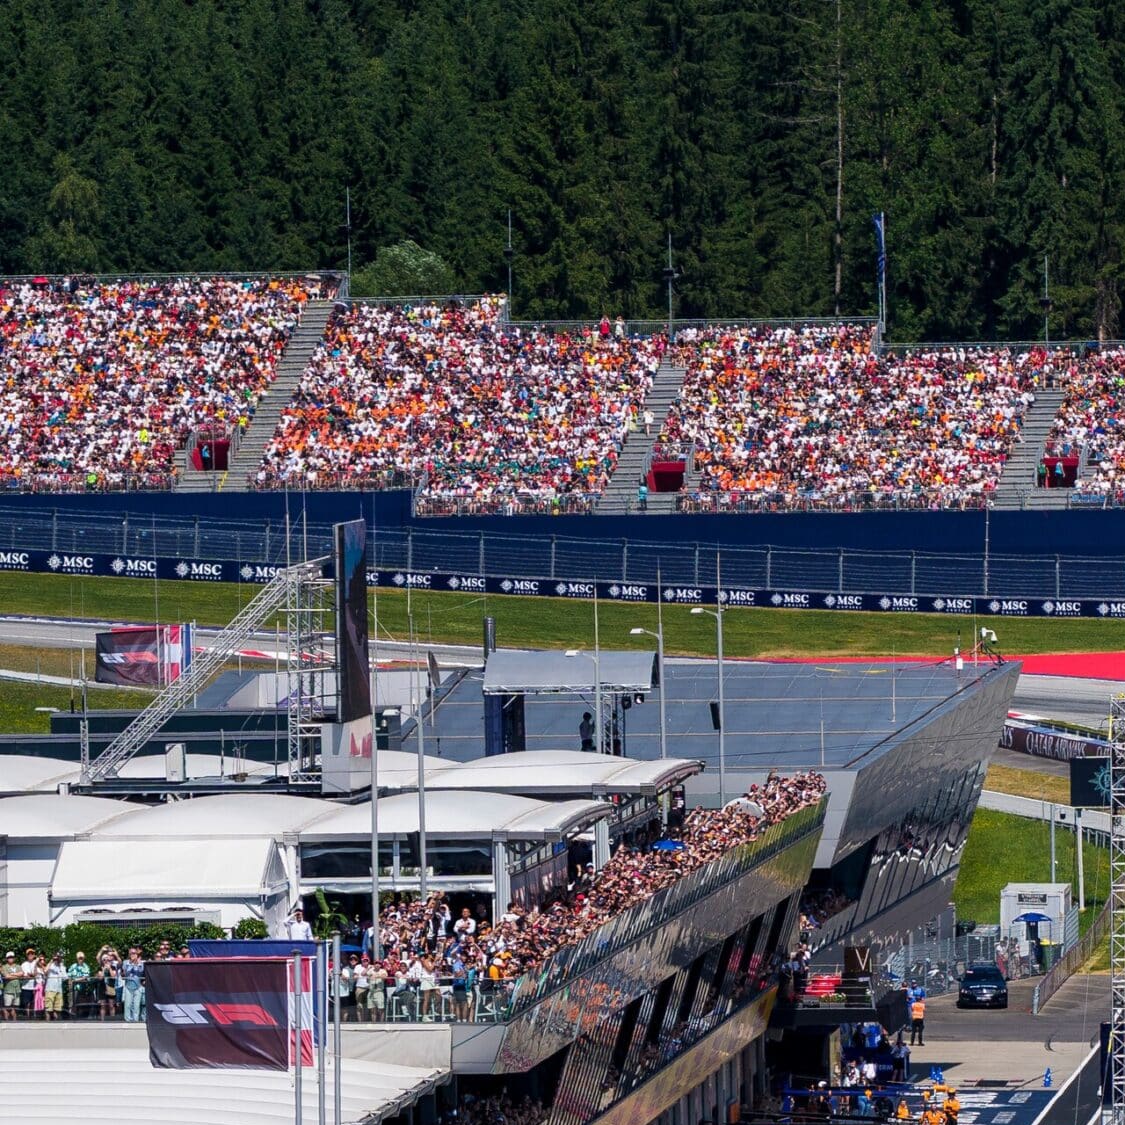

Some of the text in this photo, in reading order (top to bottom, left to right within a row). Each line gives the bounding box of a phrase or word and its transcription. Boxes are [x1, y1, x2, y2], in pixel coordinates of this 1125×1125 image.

[0, 553, 29, 565] MSC
[63, 557, 93, 568] MSC
[127, 560, 157, 572] MSC
[191, 563, 222, 575] MSC
[367, 573, 378, 581] SC
[407, 574, 431, 584] MSC
[461, 578, 486, 587] MSC
[514, 580, 539, 590] MSC
[569, 583, 594, 593] MSC
[622, 586, 647, 596] MSC
[676, 589, 702, 599] MSC
[730, 591, 755, 601] MSC
[784, 594, 809, 604] MSC
[838, 596, 862, 606] MSC
[893, 598, 918, 607] MSC
[947, 599, 972, 609] MSC
[1002, 601, 1027, 610] MSC
[1056, 602, 1081, 612] MSC
[1026, 731, 1053, 756] QATAR
[1055, 736, 1087, 758] AIRWAYS
